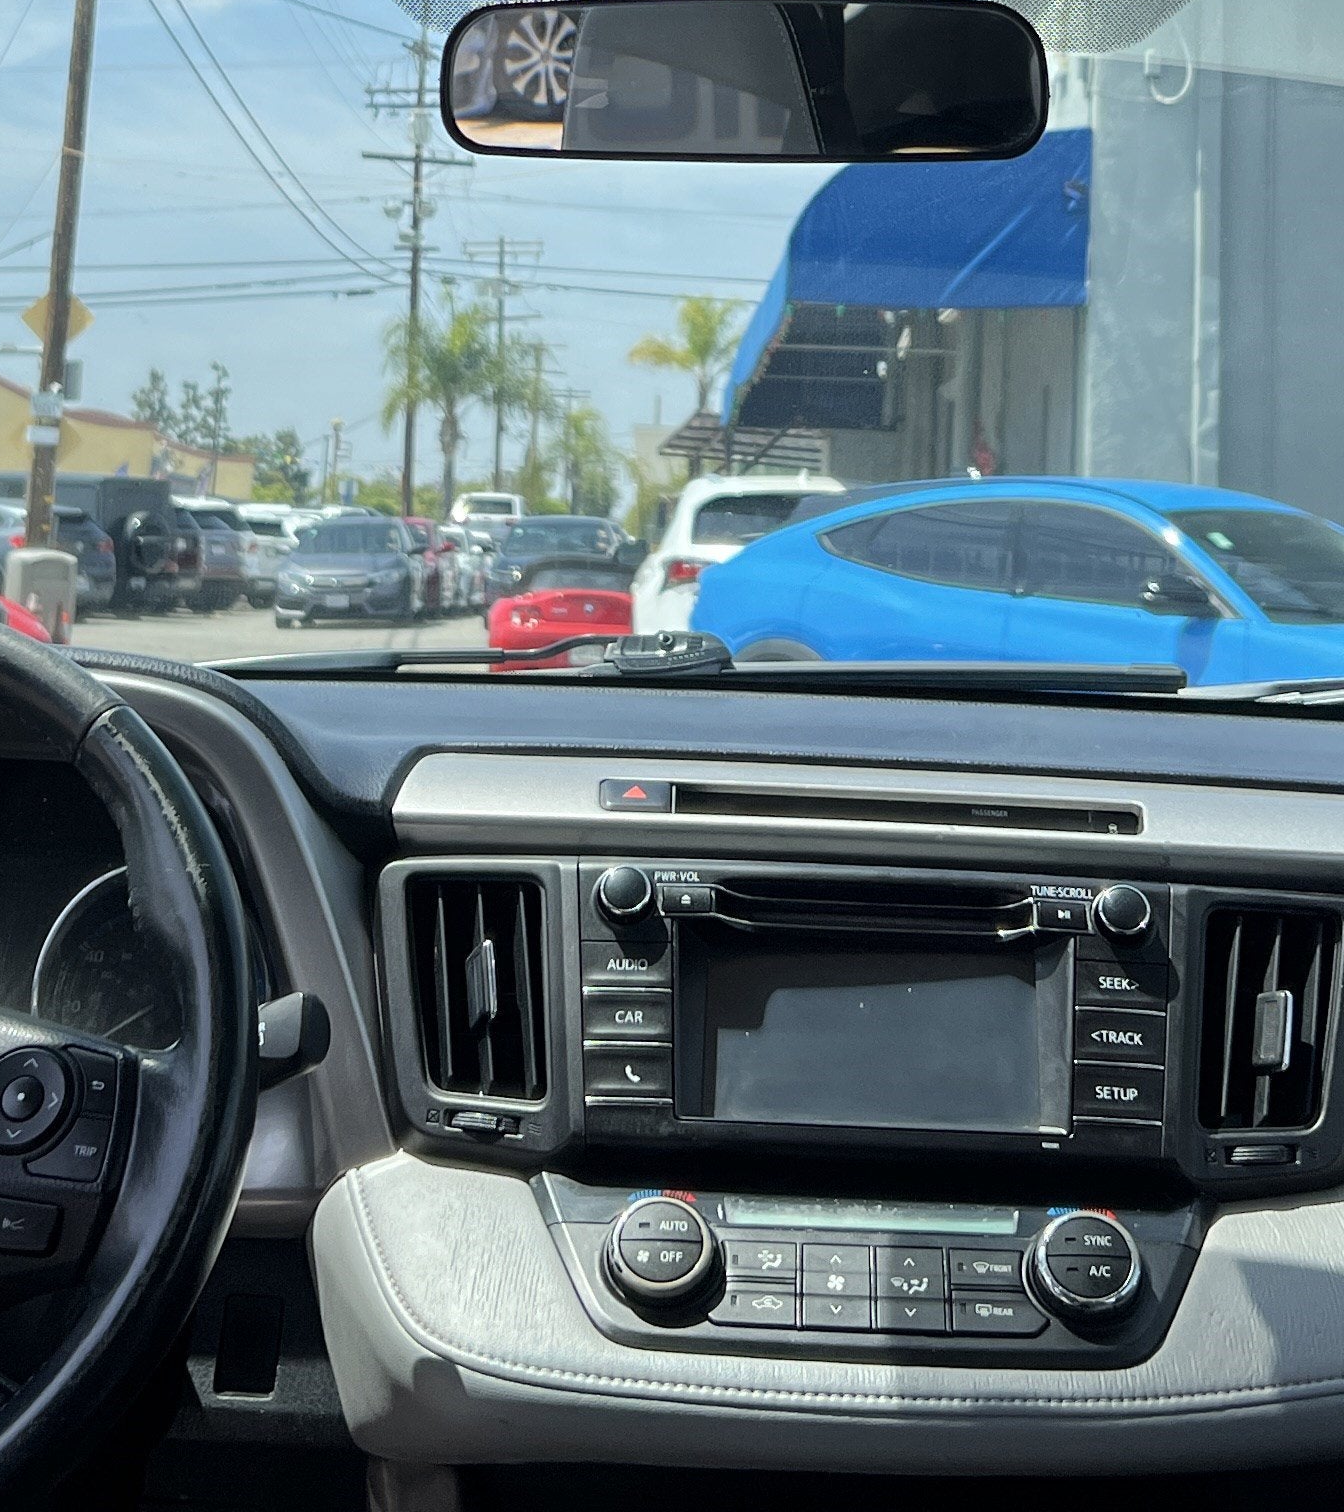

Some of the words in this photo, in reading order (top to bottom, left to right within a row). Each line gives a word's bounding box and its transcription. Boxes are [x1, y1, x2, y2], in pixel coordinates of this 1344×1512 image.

[971, 808, 1009, 817] PASSENGER
[606, 958, 648, 971] AUDIO
[615, 1010, 644, 1024] CAR
[1095, 1085, 1139, 1101] SETUP
[74, 1144, 98, 1157] TRIP
[659, 1220, 689, 1232] AUTO
[1082, 1234, 1113, 1247] SYNC
[660, 1250, 684, 1263] OFF
[989, 1264, 1013, 1273] FRONT
[1089, 1265, 1112, 1278] A/C
[992, 1307, 1014, 1317] REAR
